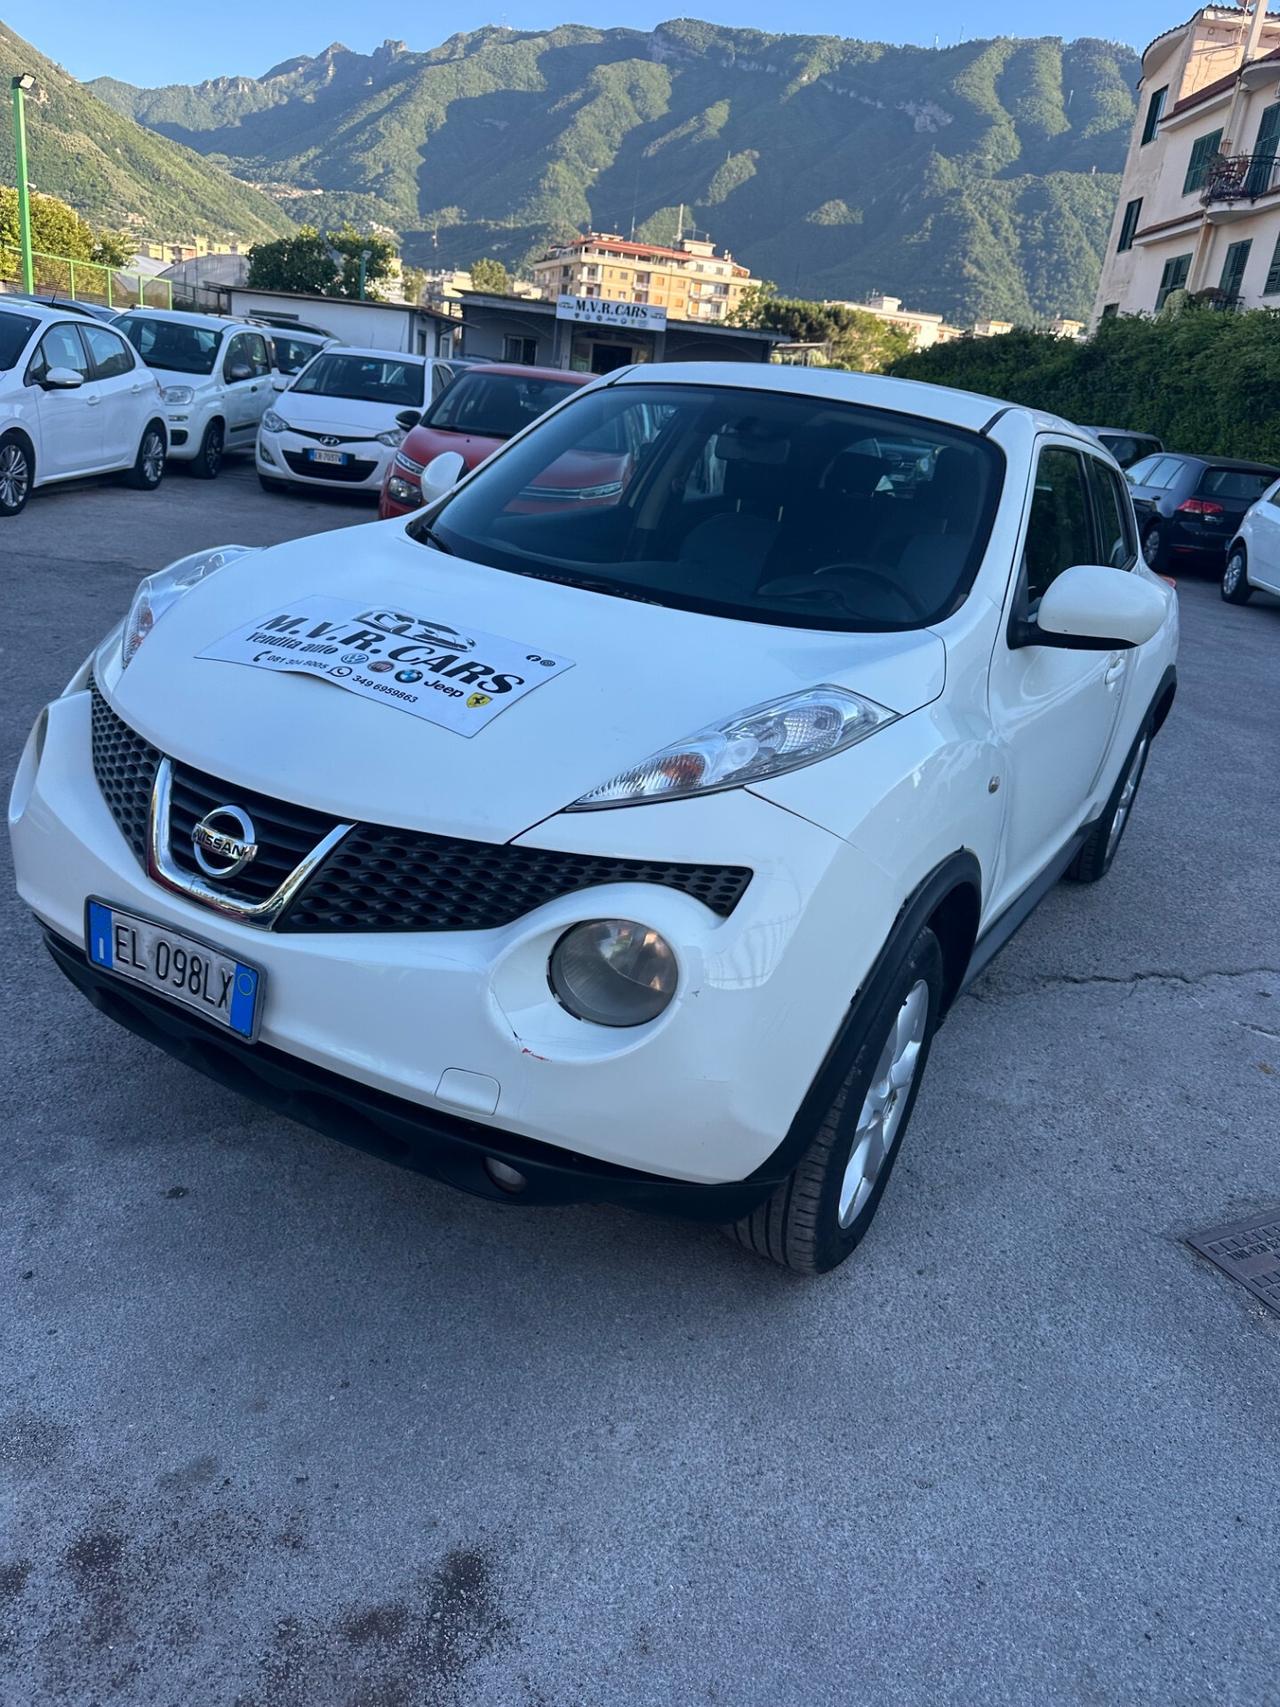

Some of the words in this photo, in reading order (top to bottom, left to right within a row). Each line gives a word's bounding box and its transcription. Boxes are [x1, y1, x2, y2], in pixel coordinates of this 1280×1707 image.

[246, 632, 303, 649] Vendita
[299, 643, 338, 655] auto
[352, 675, 374, 687] 349
[373, 684, 418, 703] 6959863
[424, 680, 464, 697] Jeep
[192, 828, 249, 857] NISSAN
